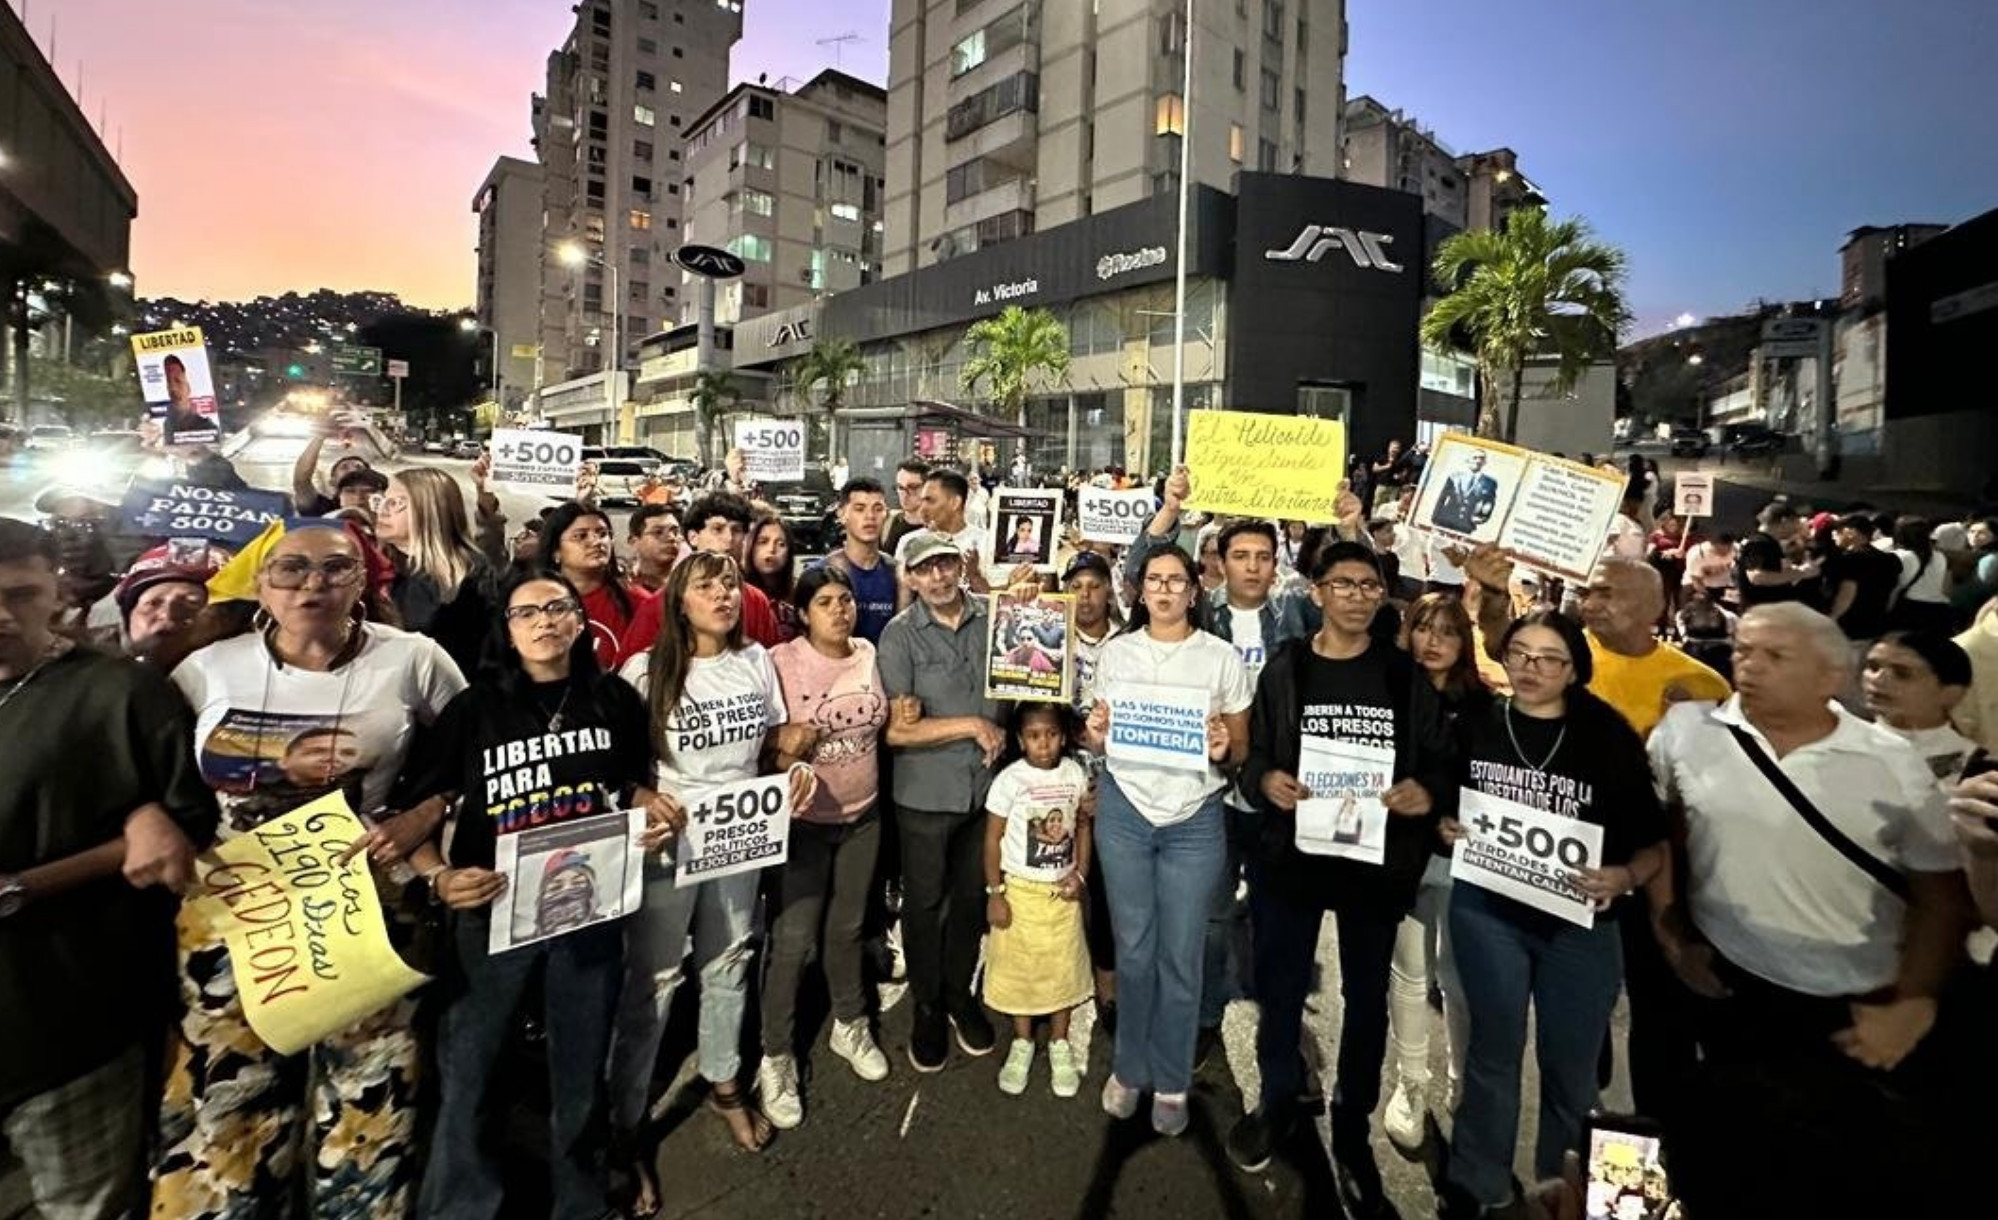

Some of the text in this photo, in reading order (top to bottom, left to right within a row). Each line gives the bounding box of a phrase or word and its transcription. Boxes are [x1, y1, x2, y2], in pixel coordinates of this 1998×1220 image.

[974, 277, 1038, 305] Av. Victoria
[140, 330, 196, 350] LIBERTAD
[742, 428, 801, 450] +500
[1232, 418, 1332, 447] Helicoide
[498, 442, 575, 466] +500
[168, 484, 236, 503] NOS
[148, 497, 281, 525] FALTAN
[1084, 498, 1150, 519] +500
[169, 515, 235, 533] 500
[726, 695, 736, 709] A
[1112, 700, 1204, 719] LAS VÍCTIMAS
[1345, 704, 1354, 716] A
[1354, 705, 1394, 721] TODOS
[677, 703, 766, 733] LOS PRESO
[1113, 711, 1204, 731] NO SOMOS UNA
[1300, 718, 1395, 737] LOS PRESOS
[677, 722, 767, 752] POLÍTICO
[1114, 726, 1202, 752] TONTERÍA
[483, 727, 612, 777] LIBERTAD
[486, 762, 553, 805] PARA
[1304, 771, 1386, 789] ELECCIONES YA
[1470, 759, 1593, 805] ESTUDIANTES POR LA
[486, 781, 595, 834] TODOS
[692, 785, 784, 826] +500
[305, 812, 352, 834] 6
[704, 819, 769, 845] PRESOS
[702, 833, 769, 857] POLÍTICOS
[1472, 813, 1589, 867] +500
[255, 822, 331, 888] 2190
[690, 844, 778, 872] LEJOS DE CASA
[1464, 848, 1530, 882] INTENTAN
[1467, 836, 1550, 874] VERDADES
[204, 861, 310, 1006] GEDEON
